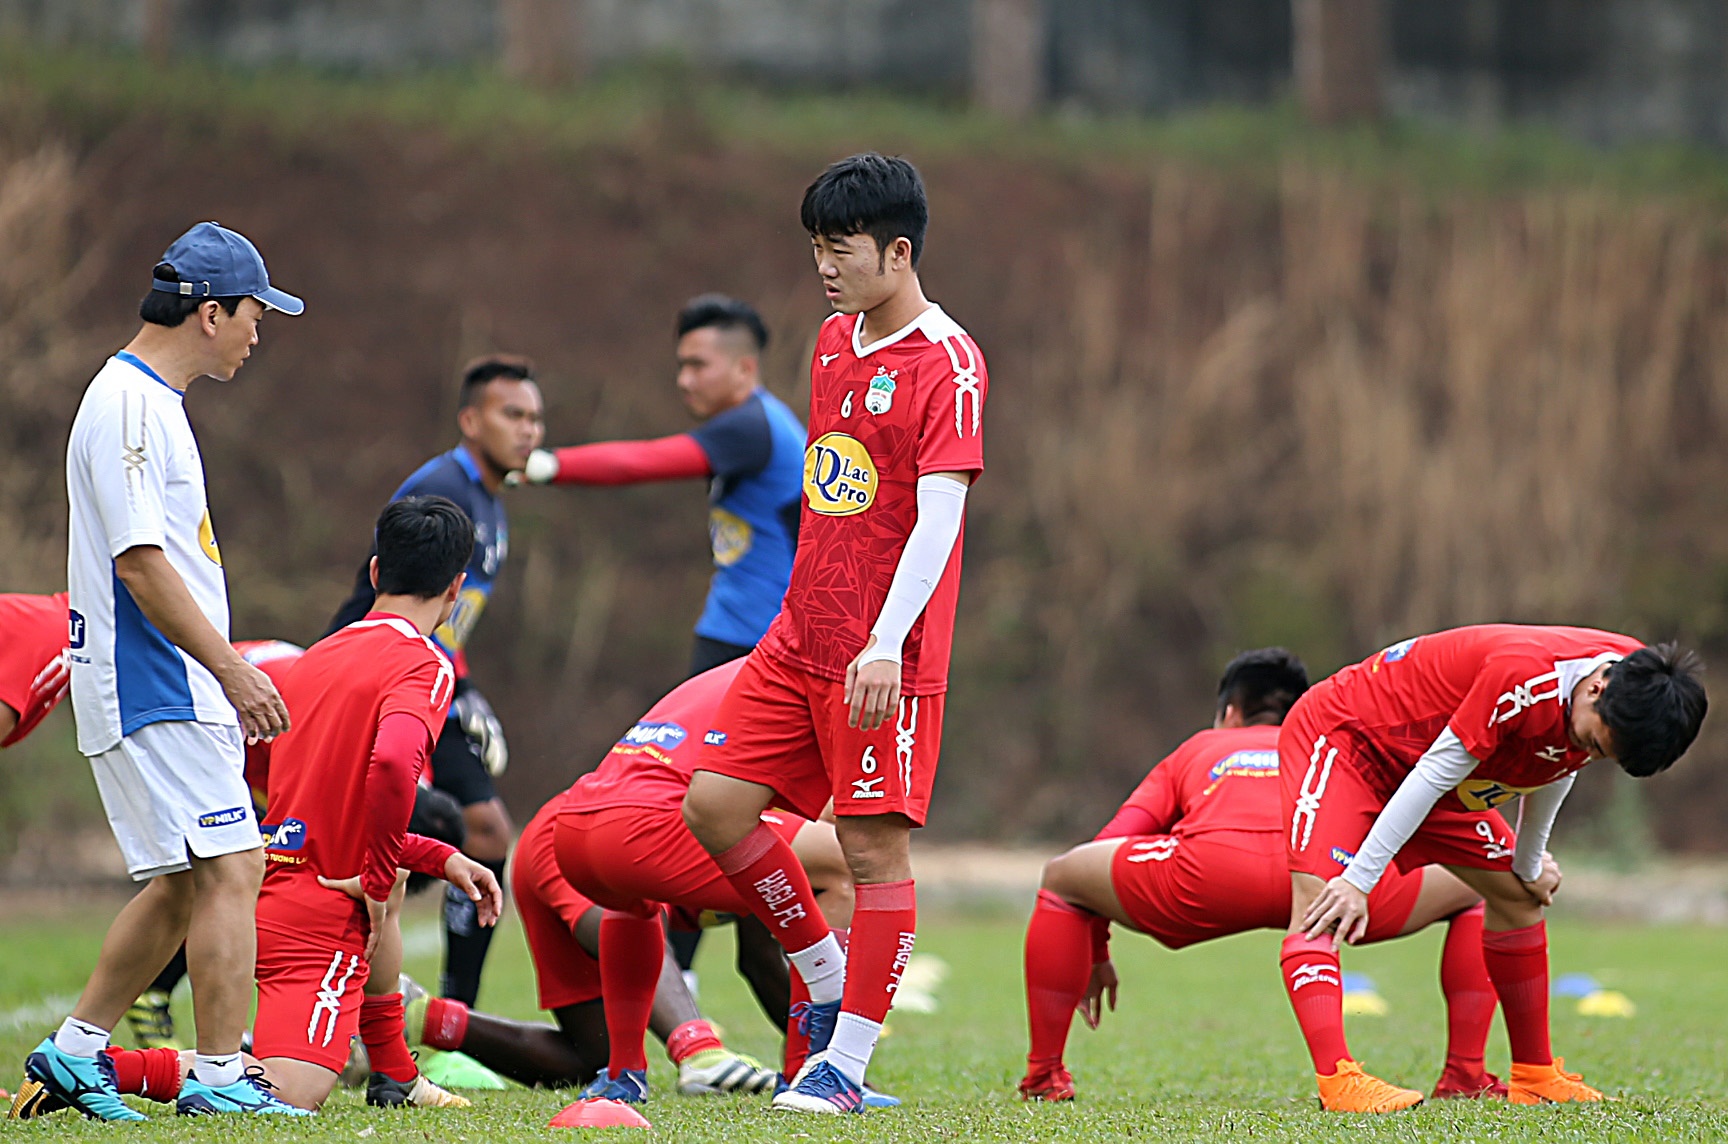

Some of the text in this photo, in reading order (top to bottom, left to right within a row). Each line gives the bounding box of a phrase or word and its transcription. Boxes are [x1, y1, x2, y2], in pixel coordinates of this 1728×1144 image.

[841, 391, 854, 418] 6
[811, 446, 869, 502] IQ Lac
[836, 482, 868, 504] Pro
[624, 725, 684, 743] MILK
[861, 745, 877, 774] 6
[1475, 820, 1495, 843] 9
[753, 868, 807, 929] HAGL FC
[885, 931, 916, 993] HAGL FC
